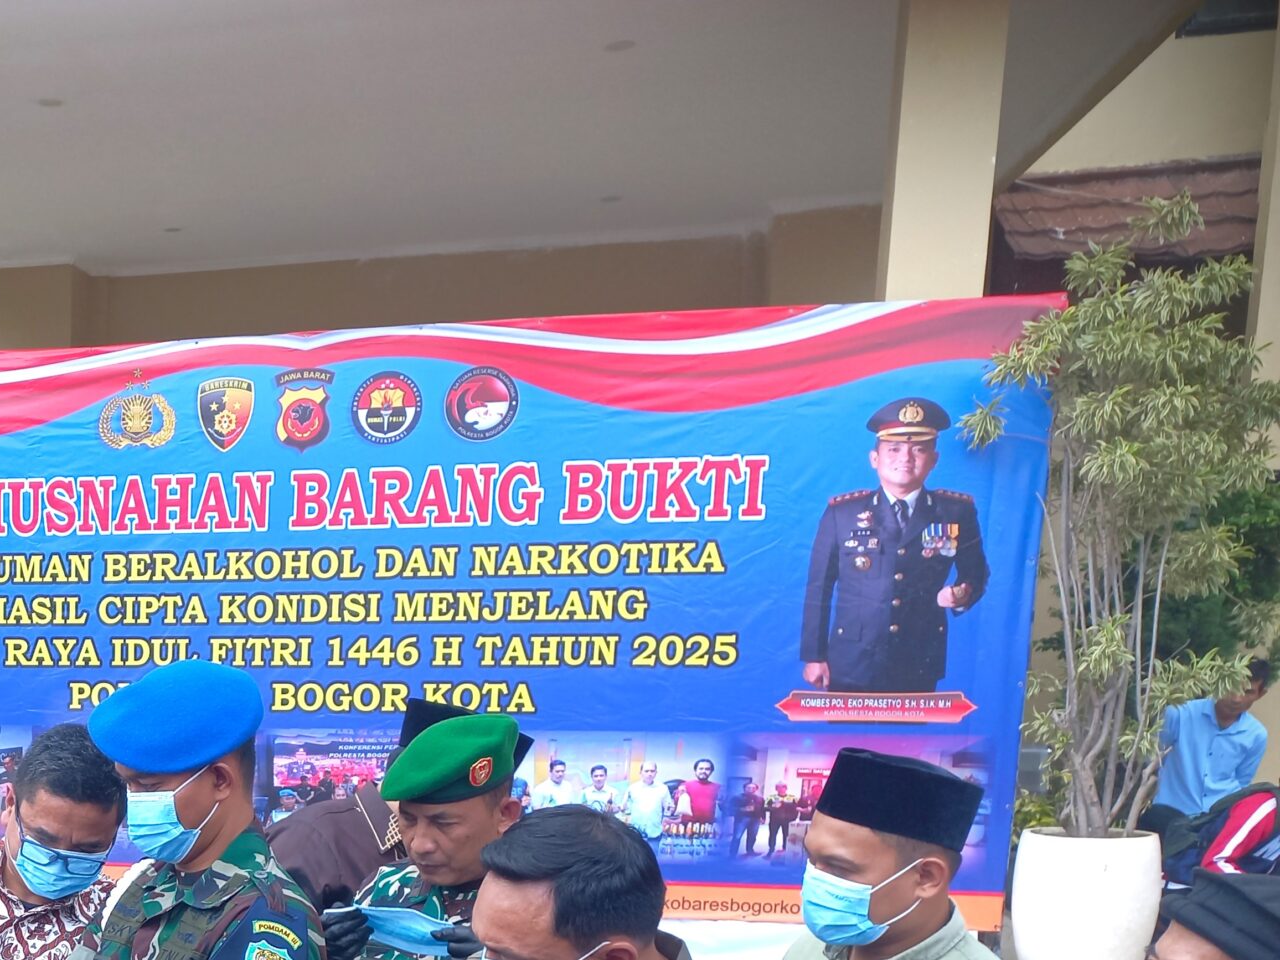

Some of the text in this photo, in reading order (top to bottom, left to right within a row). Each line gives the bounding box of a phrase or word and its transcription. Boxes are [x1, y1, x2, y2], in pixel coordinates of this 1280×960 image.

[279, 371, 331, 384] JAWA BARAT
[290, 464, 542, 531] BARANG
[562, 456, 770, 524] BUKTI
[102, 548, 359, 583] BERALKOHOL
[377, 546, 456, 577] DAN
[471, 541, 726, 577] NARKOTIKA
[98, 595, 209, 625] CIPTA
[218, 592, 381, 624] KONDISI
[392, 589, 648, 623] MENJELANG
[3, 638, 102, 668] RAYA
[110, 637, 198, 667] IDUL
[208, 635, 312, 667] FITRI
[326, 636, 419, 667] 1446
[431, 635, 463, 667] H
[473, 634, 620, 667] TAHUN
[630, 633, 738, 667] 2025
[272, 682, 535, 713] BOGOR KOTA
[800, 698, 830, 708] KOMBES
[831, 698, 845, 708] POL
[847, 698, 863, 708] EKO
[864, 698, 901, 709] PRASETYO
[874, 710, 902, 718] BOGOR
[904, 710, 925, 718] KOTA
[258, 923, 290, 938] POMDAM
